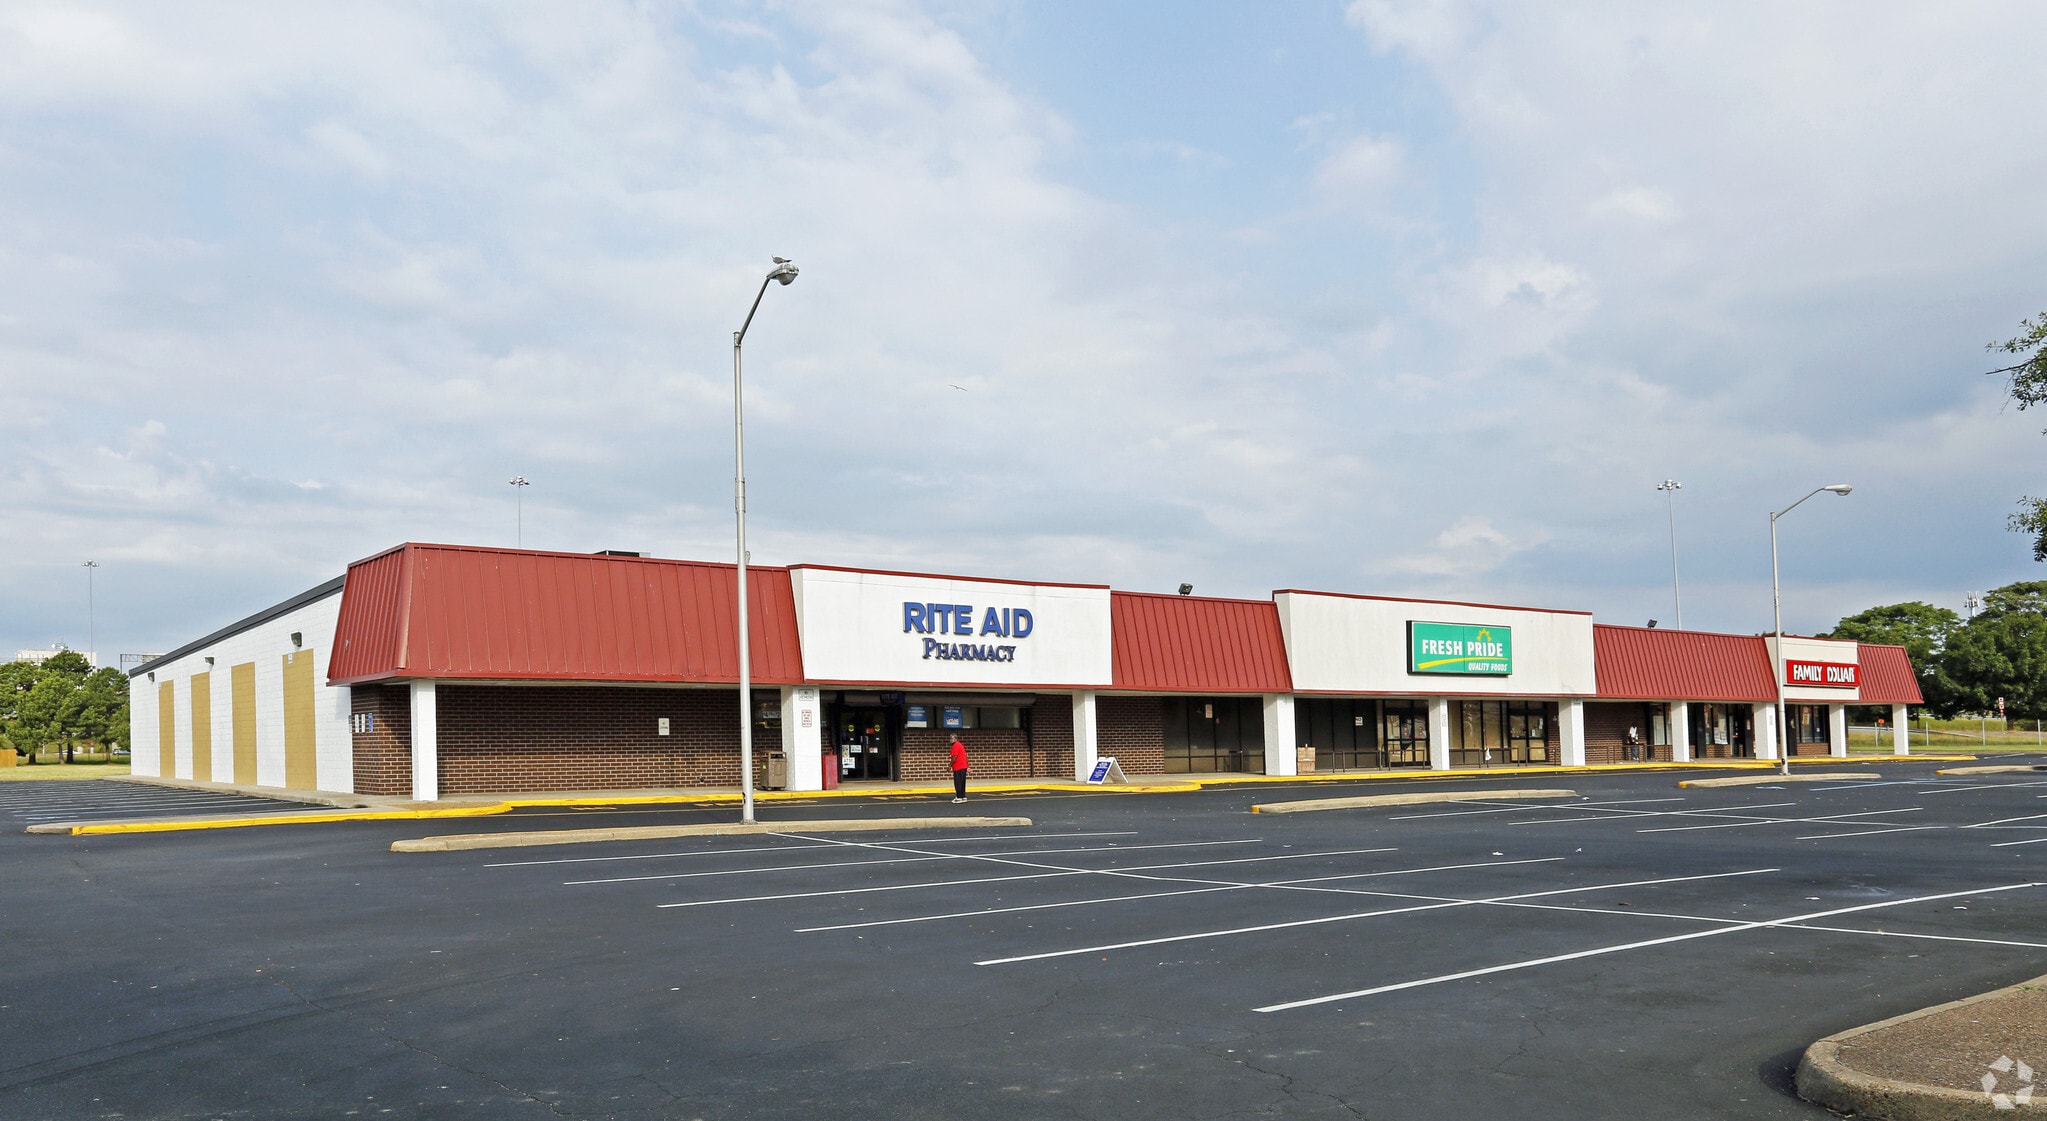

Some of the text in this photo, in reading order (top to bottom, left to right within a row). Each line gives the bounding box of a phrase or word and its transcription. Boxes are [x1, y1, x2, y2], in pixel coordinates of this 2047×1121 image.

[902, 601, 1033, 638] RITE AID
[922, 637, 1017, 662] PHARMACY
[1422, 639, 1503, 657] FRESH PRIDE
[1468, 662, 1508, 672] QUALITY FOODS
[1793, 664, 1855, 683] FAMILY DOLLAR
